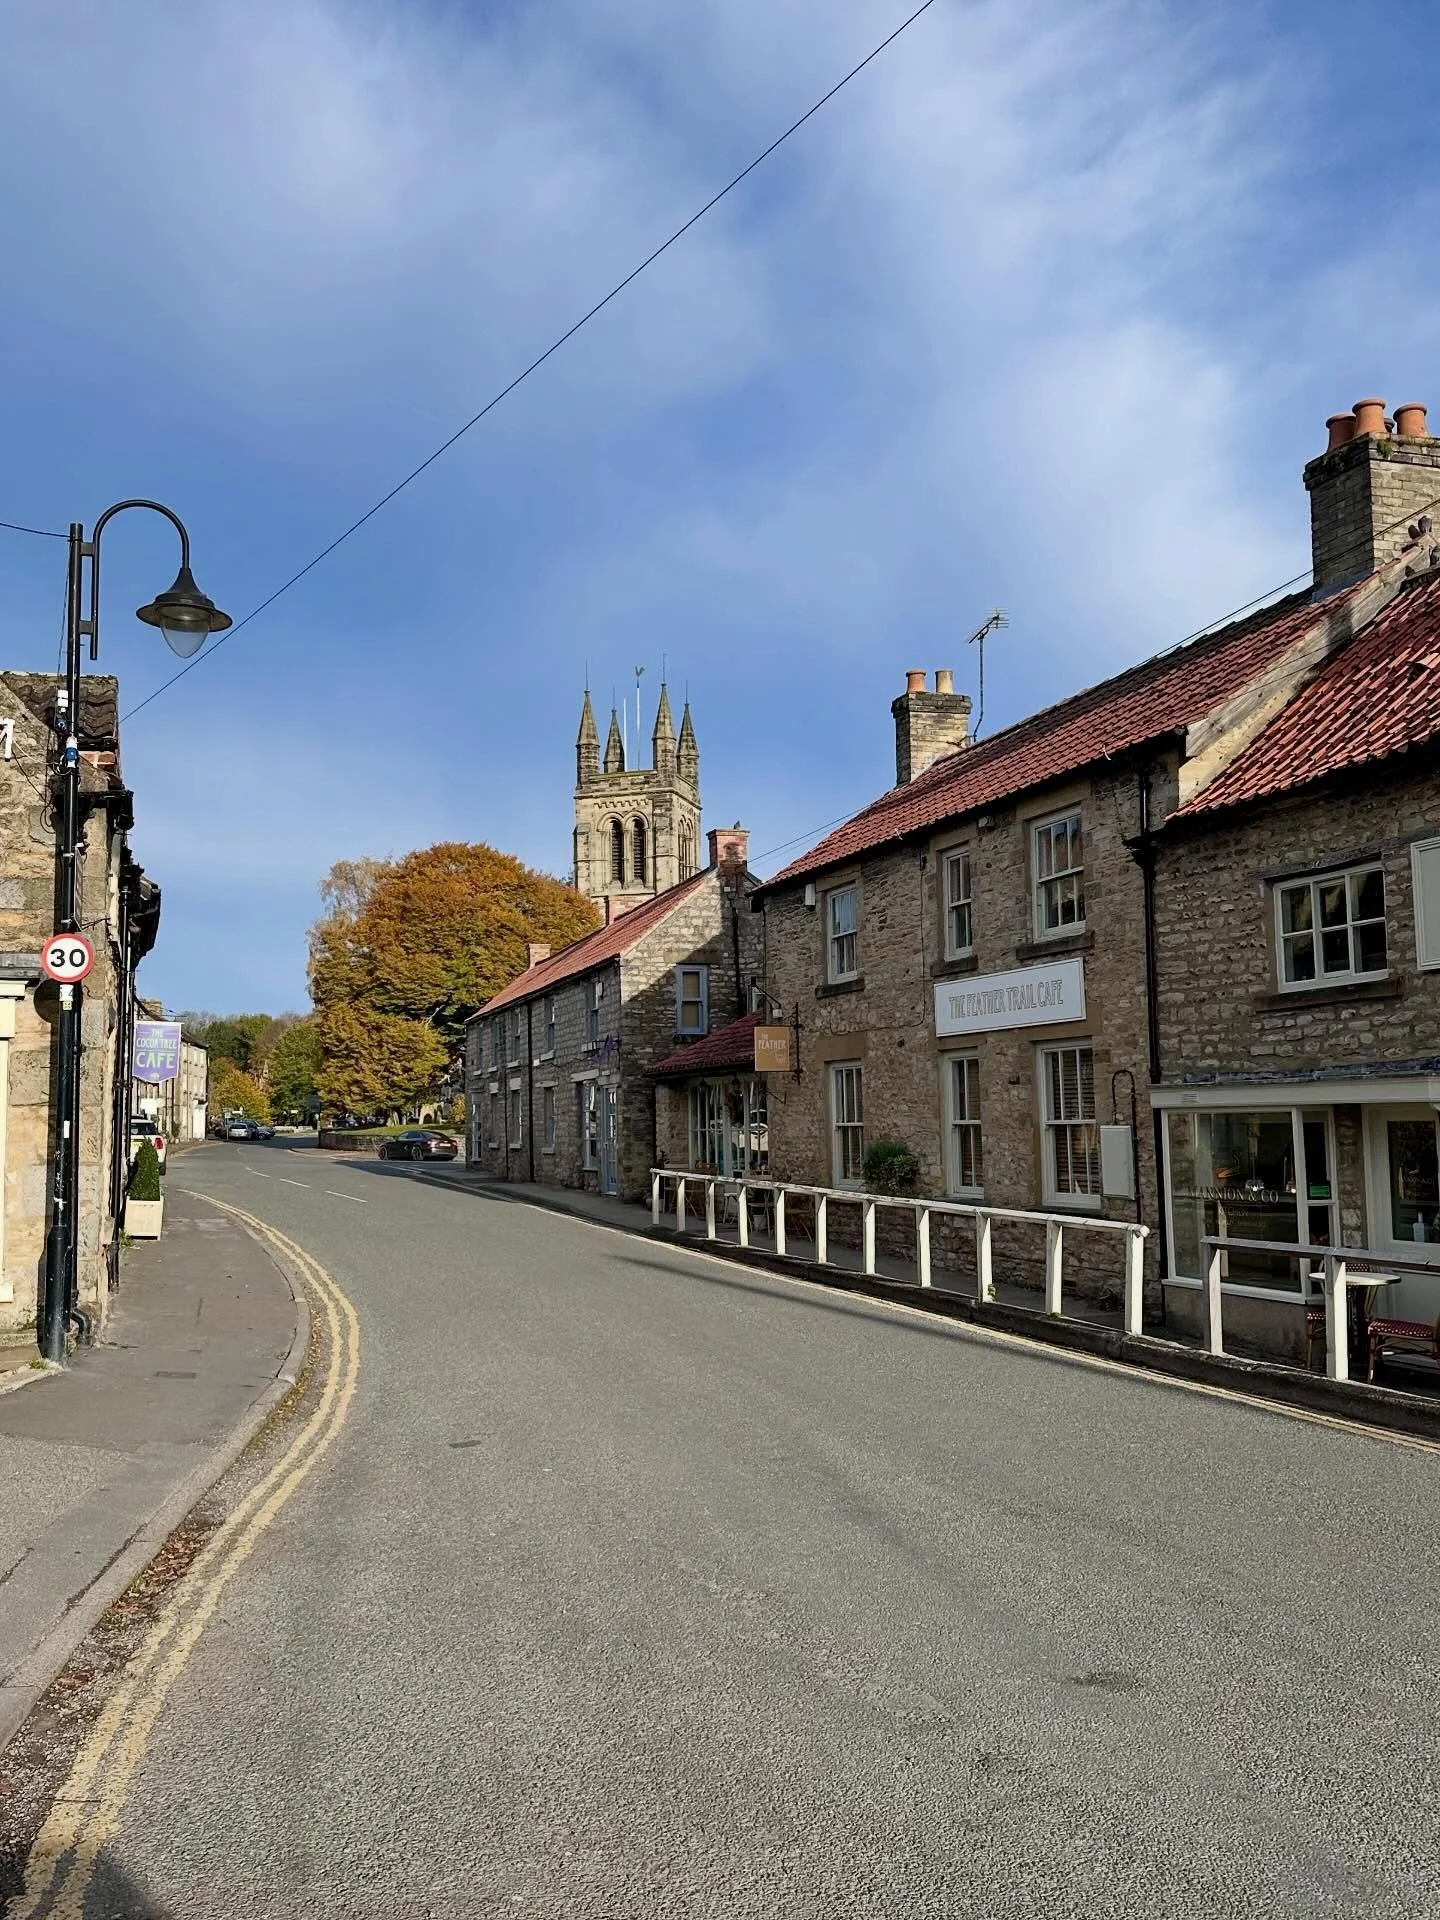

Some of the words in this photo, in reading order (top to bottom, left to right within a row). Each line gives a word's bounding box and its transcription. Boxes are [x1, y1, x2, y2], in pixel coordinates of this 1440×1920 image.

[50, 948, 85, 968] 30
[948, 995, 966, 1020] THE
[966, 988, 1006, 1017] FEATHER
[1006, 983, 1037, 1012] TRAIL
[1036, 979, 1064, 1007] CAFE
[151, 1028, 164, 1038] THE
[136, 1038, 158, 1049] COCOA
[136, 1052, 175, 1069] CAFE
[1260, 1189, 1279, 1204] CO
